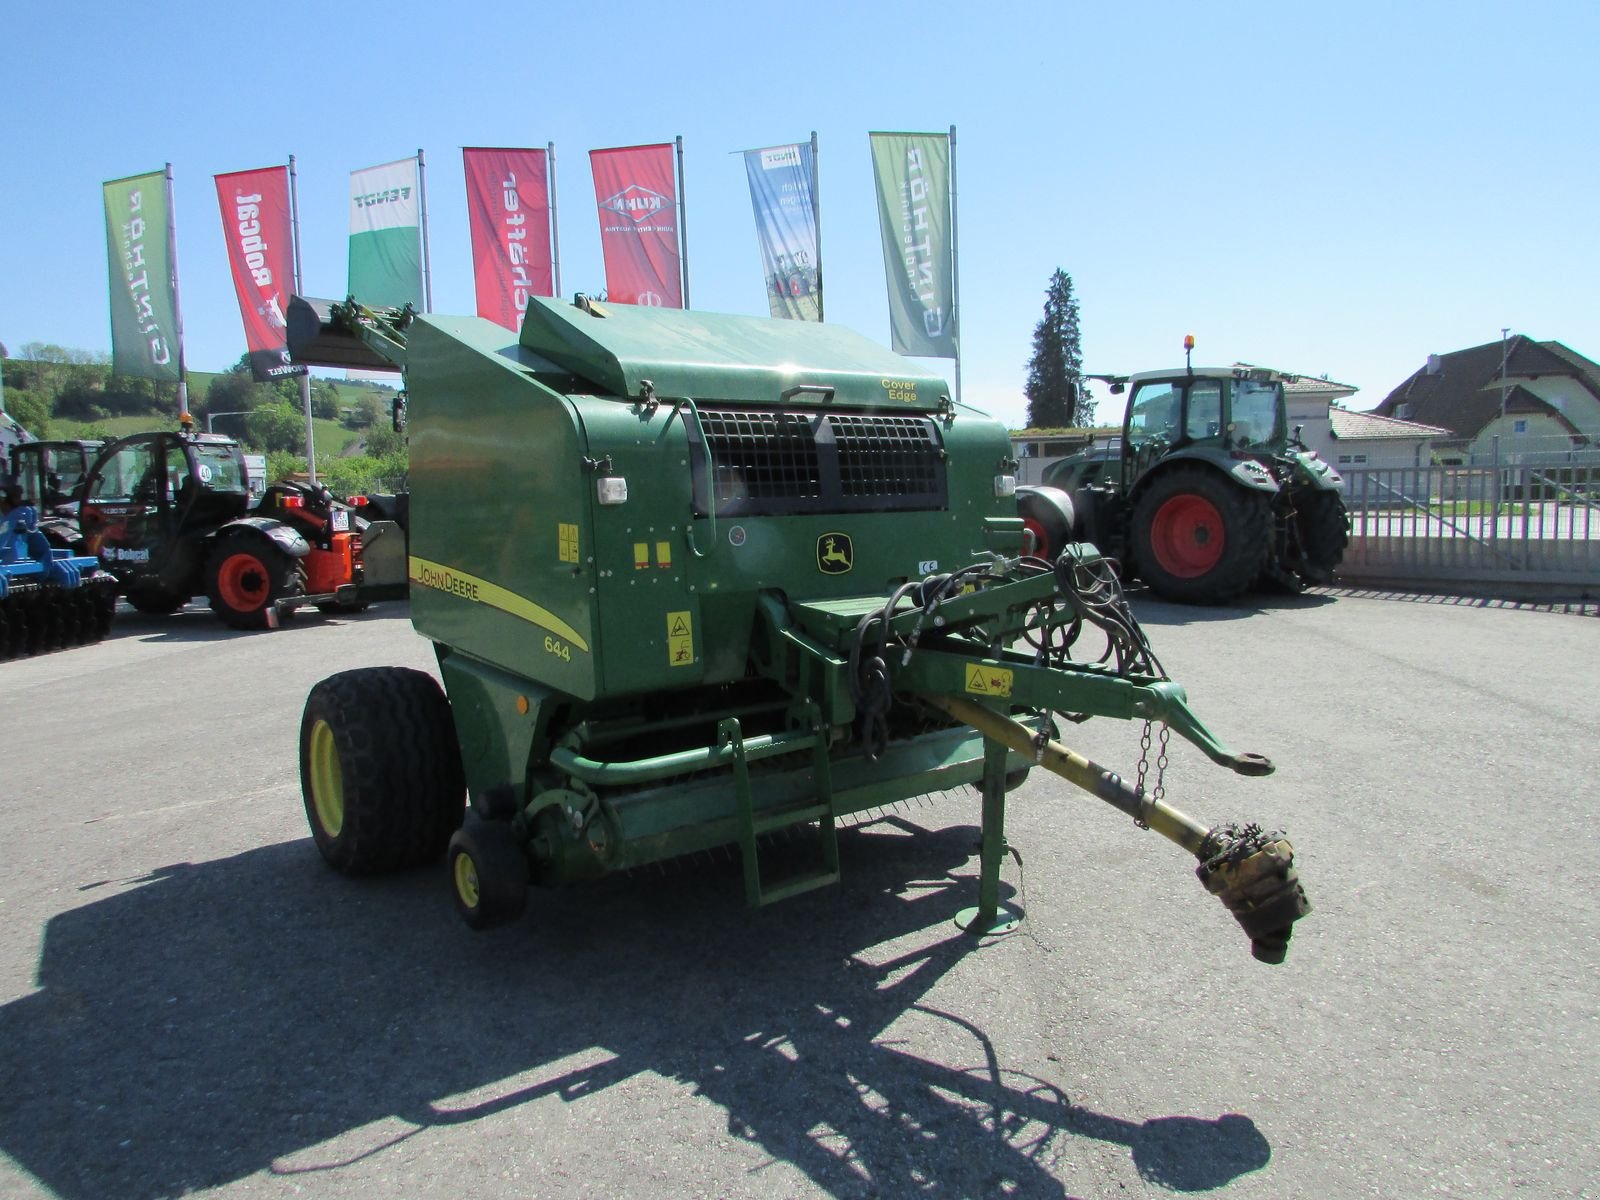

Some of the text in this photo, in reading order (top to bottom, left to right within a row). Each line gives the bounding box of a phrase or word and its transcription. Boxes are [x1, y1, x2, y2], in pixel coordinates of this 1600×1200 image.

[881, 378, 917, 391] Cover
[888, 389, 917, 403] Edge
[117, 548, 149, 561] Bobcat
[418, 564, 479, 600] JOHN DEERE
[544, 635, 571, 662] 644
